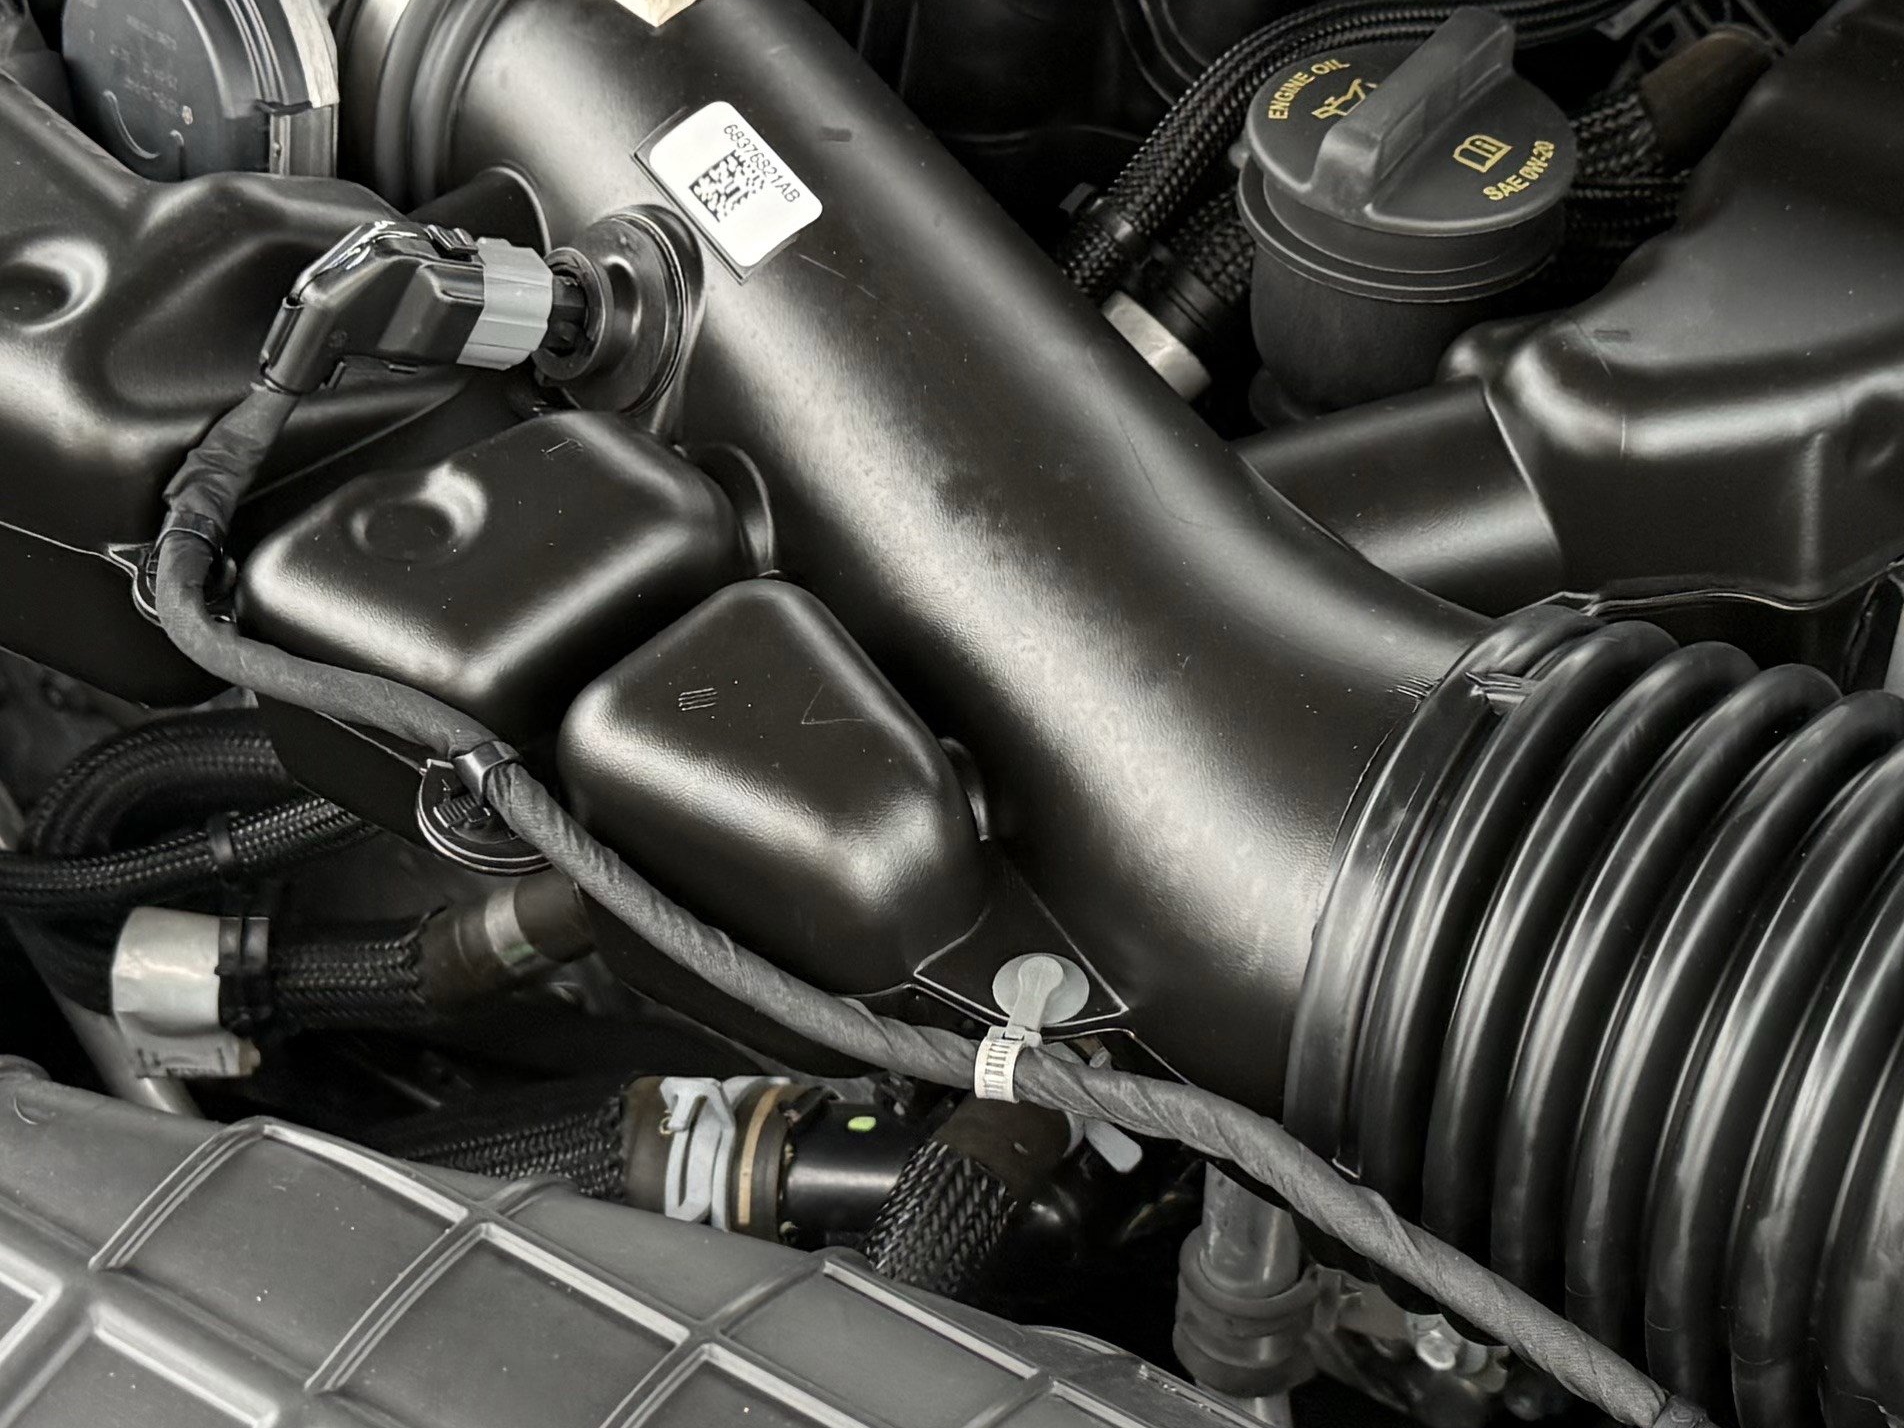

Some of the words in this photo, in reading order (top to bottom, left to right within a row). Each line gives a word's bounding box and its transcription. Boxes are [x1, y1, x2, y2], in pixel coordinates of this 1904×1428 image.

[1268, 72, 1315, 119] ENGINE
[1310, 59, 1351, 75] OIL
[723, 124, 800, 203] 68376821AB
[1483, 175, 1529, 200] SAE
[1519, 140, 1554, 180] 0W-20
